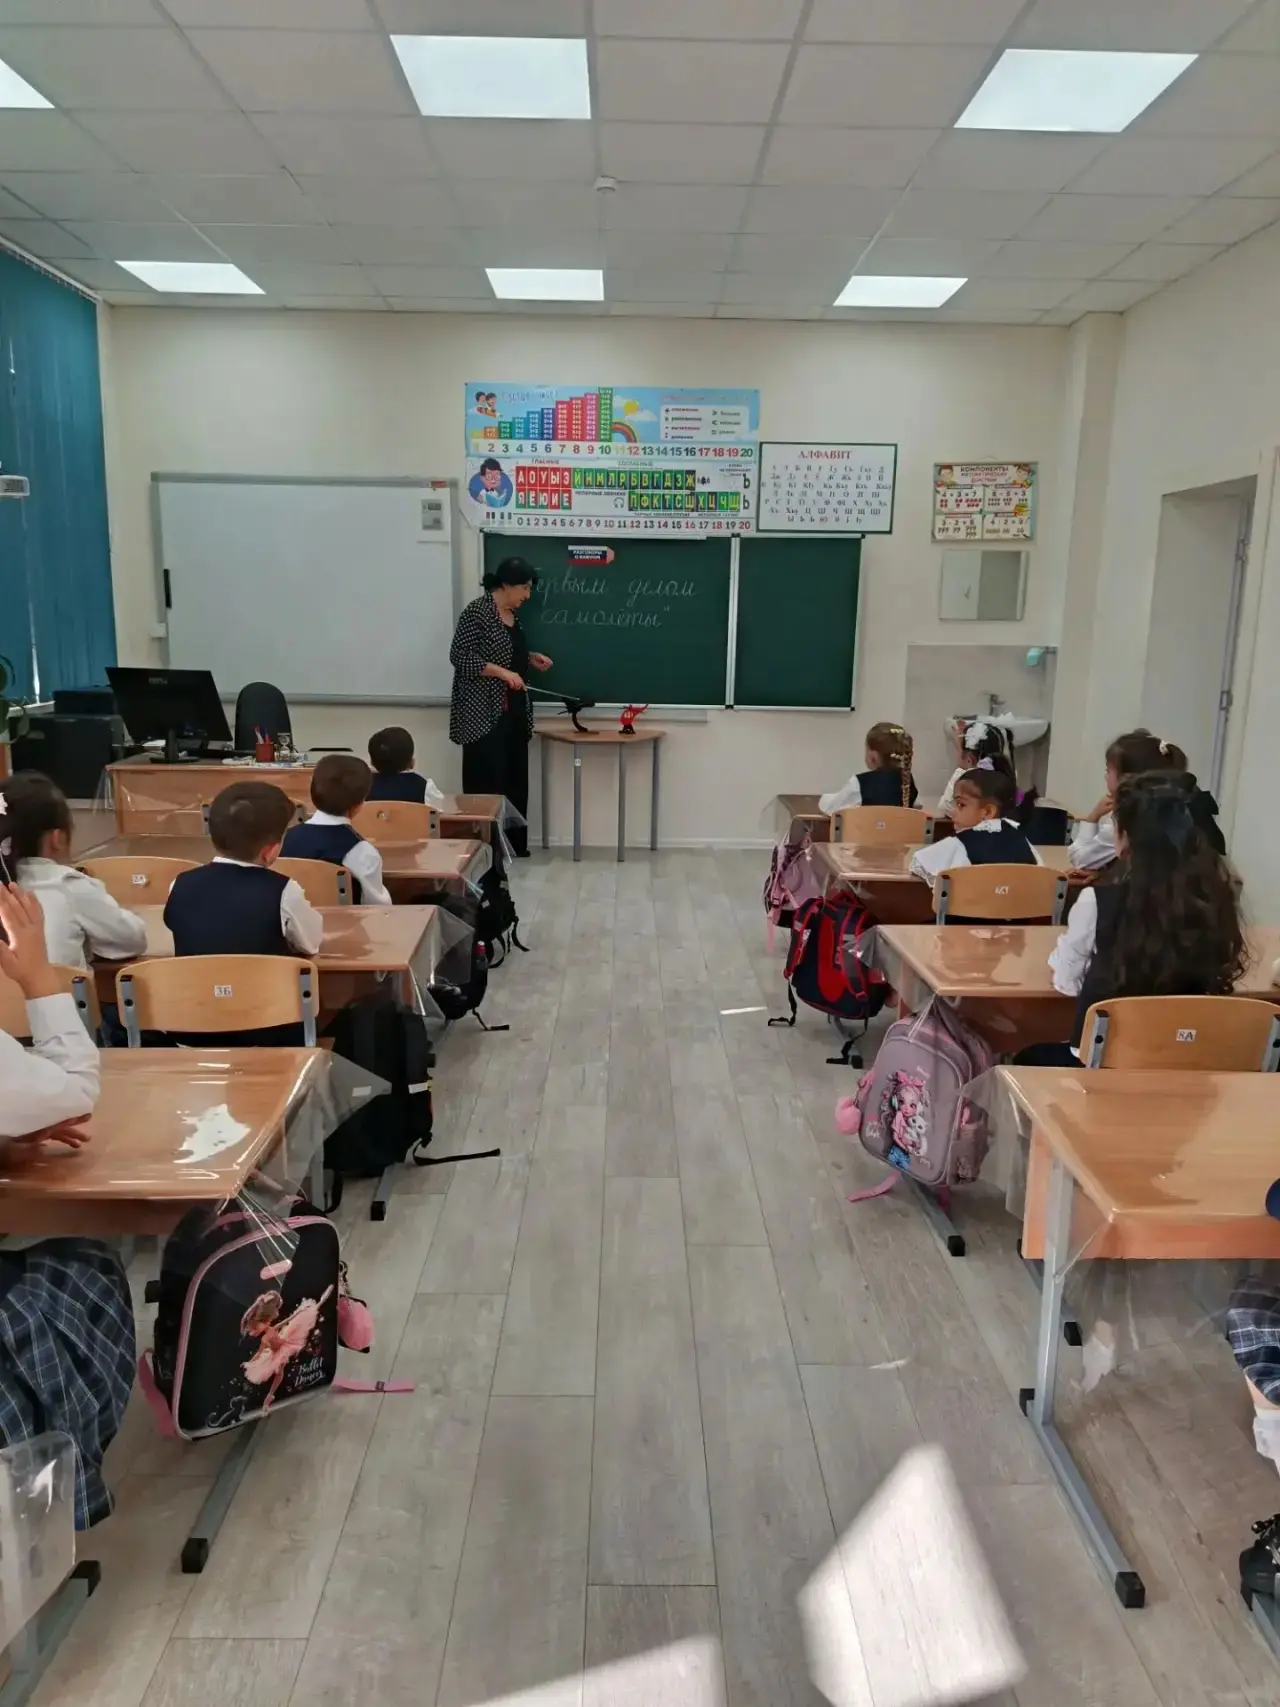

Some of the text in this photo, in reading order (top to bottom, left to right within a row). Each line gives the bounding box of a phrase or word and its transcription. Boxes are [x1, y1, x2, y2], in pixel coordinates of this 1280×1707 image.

[488, 444, 494, 452] 2
[502, 444, 508, 452] 3
[516, 444, 523, 452] 4
[531, 444, 537, 452] 5
[545, 444, 551, 453] 6
[560, 444, 566, 453] 7
[573, 445, 580, 453] 8
[588, 445, 594, 454] 9
[599, 445, 611, 454] 10
[628, 446, 639, 455] 12
[642, 446, 653, 455] 13
[656, 447, 668, 456] 14
[670, 447, 682, 456] 15
[684, 447, 696, 456] 16
[698, 448, 710, 456] 17
[713, 448, 724, 457] 18
[727, 448, 738, 457] 19
[741, 448, 752, 457] 20
[799, 450, 852, 459] АЛФАВИТ
[518, 470, 695, 487] А О У Ы Э Й Н М Л Р Б В Г Д З Ж
[518, 491, 739, 510] Я Ё Ю И Е П Ф К Т С Ш Х Ц Ч Щ
[517, 517, 523, 525] 0
[534, 518, 539, 526] 2
[542, 518, 548, 526] 3
[551, 518, 557, 526] 4
[569, 519, 575, 527] 6
[586, 519, 592, 527] 8
[535, 566, 608, 604] ервым
